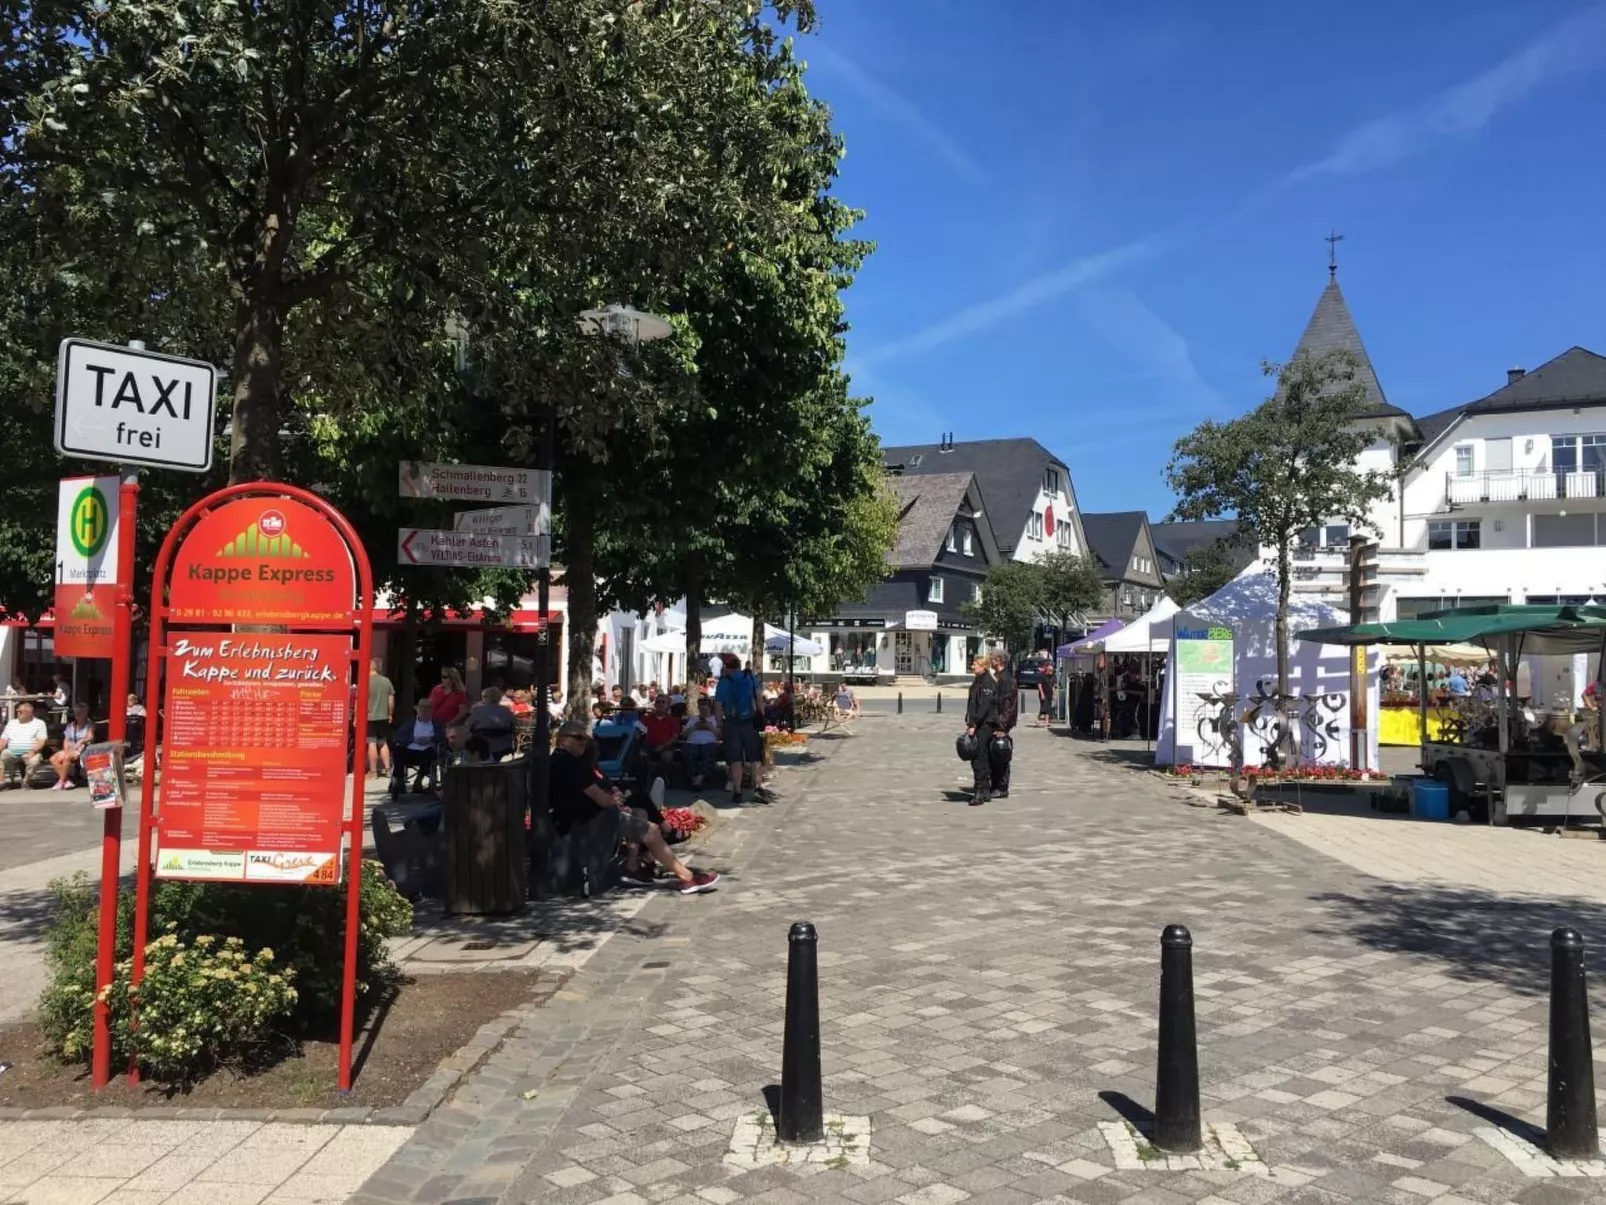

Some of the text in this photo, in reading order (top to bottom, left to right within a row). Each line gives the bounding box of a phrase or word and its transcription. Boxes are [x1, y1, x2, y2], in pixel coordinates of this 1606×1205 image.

[86, 364, 192, 420] TAXI
[116, 422, 161, 449] frei
[432, 468, 515, 485] Schmallenberg
[431, 482, 492, 496] Hallenberg
[188, 564, 335, 585] Kappe Express
[83, 624, 113, 639] Express
[174, 639, 319, 661] Zum Erlebnisberg
[183, 660, 337, 683] Kappe und zurück.
[249, 855, 271, 864] TAXI
